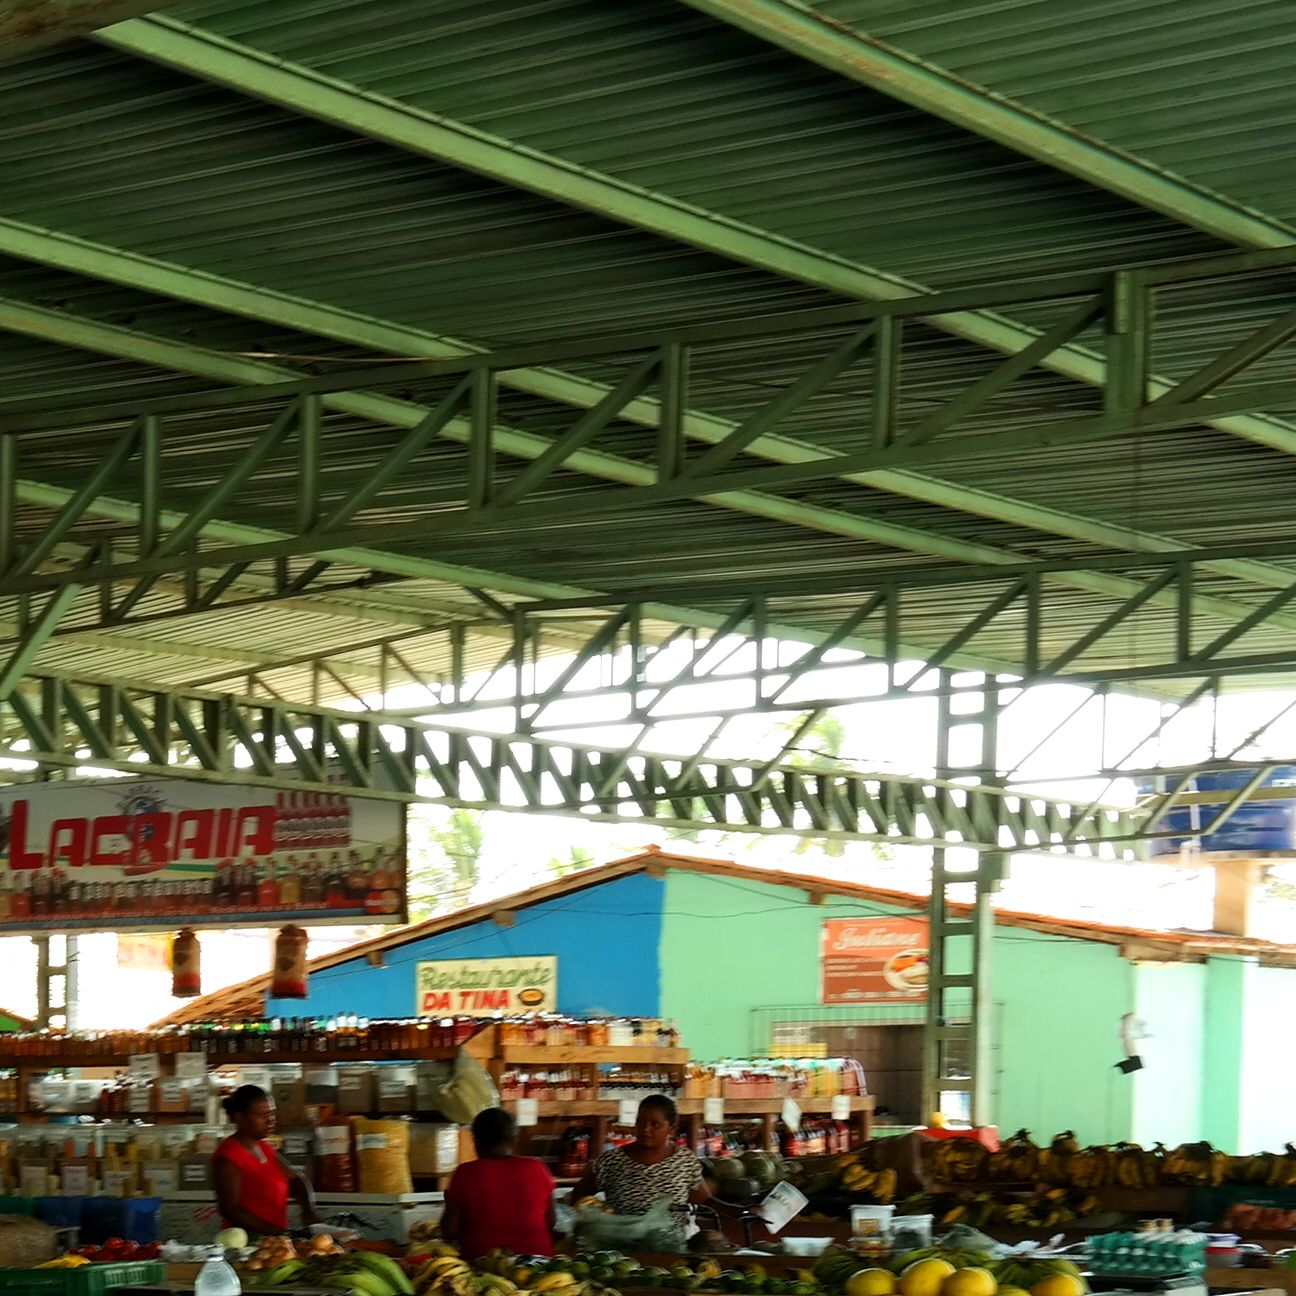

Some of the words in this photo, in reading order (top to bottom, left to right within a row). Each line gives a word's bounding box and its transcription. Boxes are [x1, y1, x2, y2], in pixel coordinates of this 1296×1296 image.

[8, 800, 275, 876] LACRAIA
[423, 992, 450, 1011] DA
[460, 990, 511, 1009] TINA
